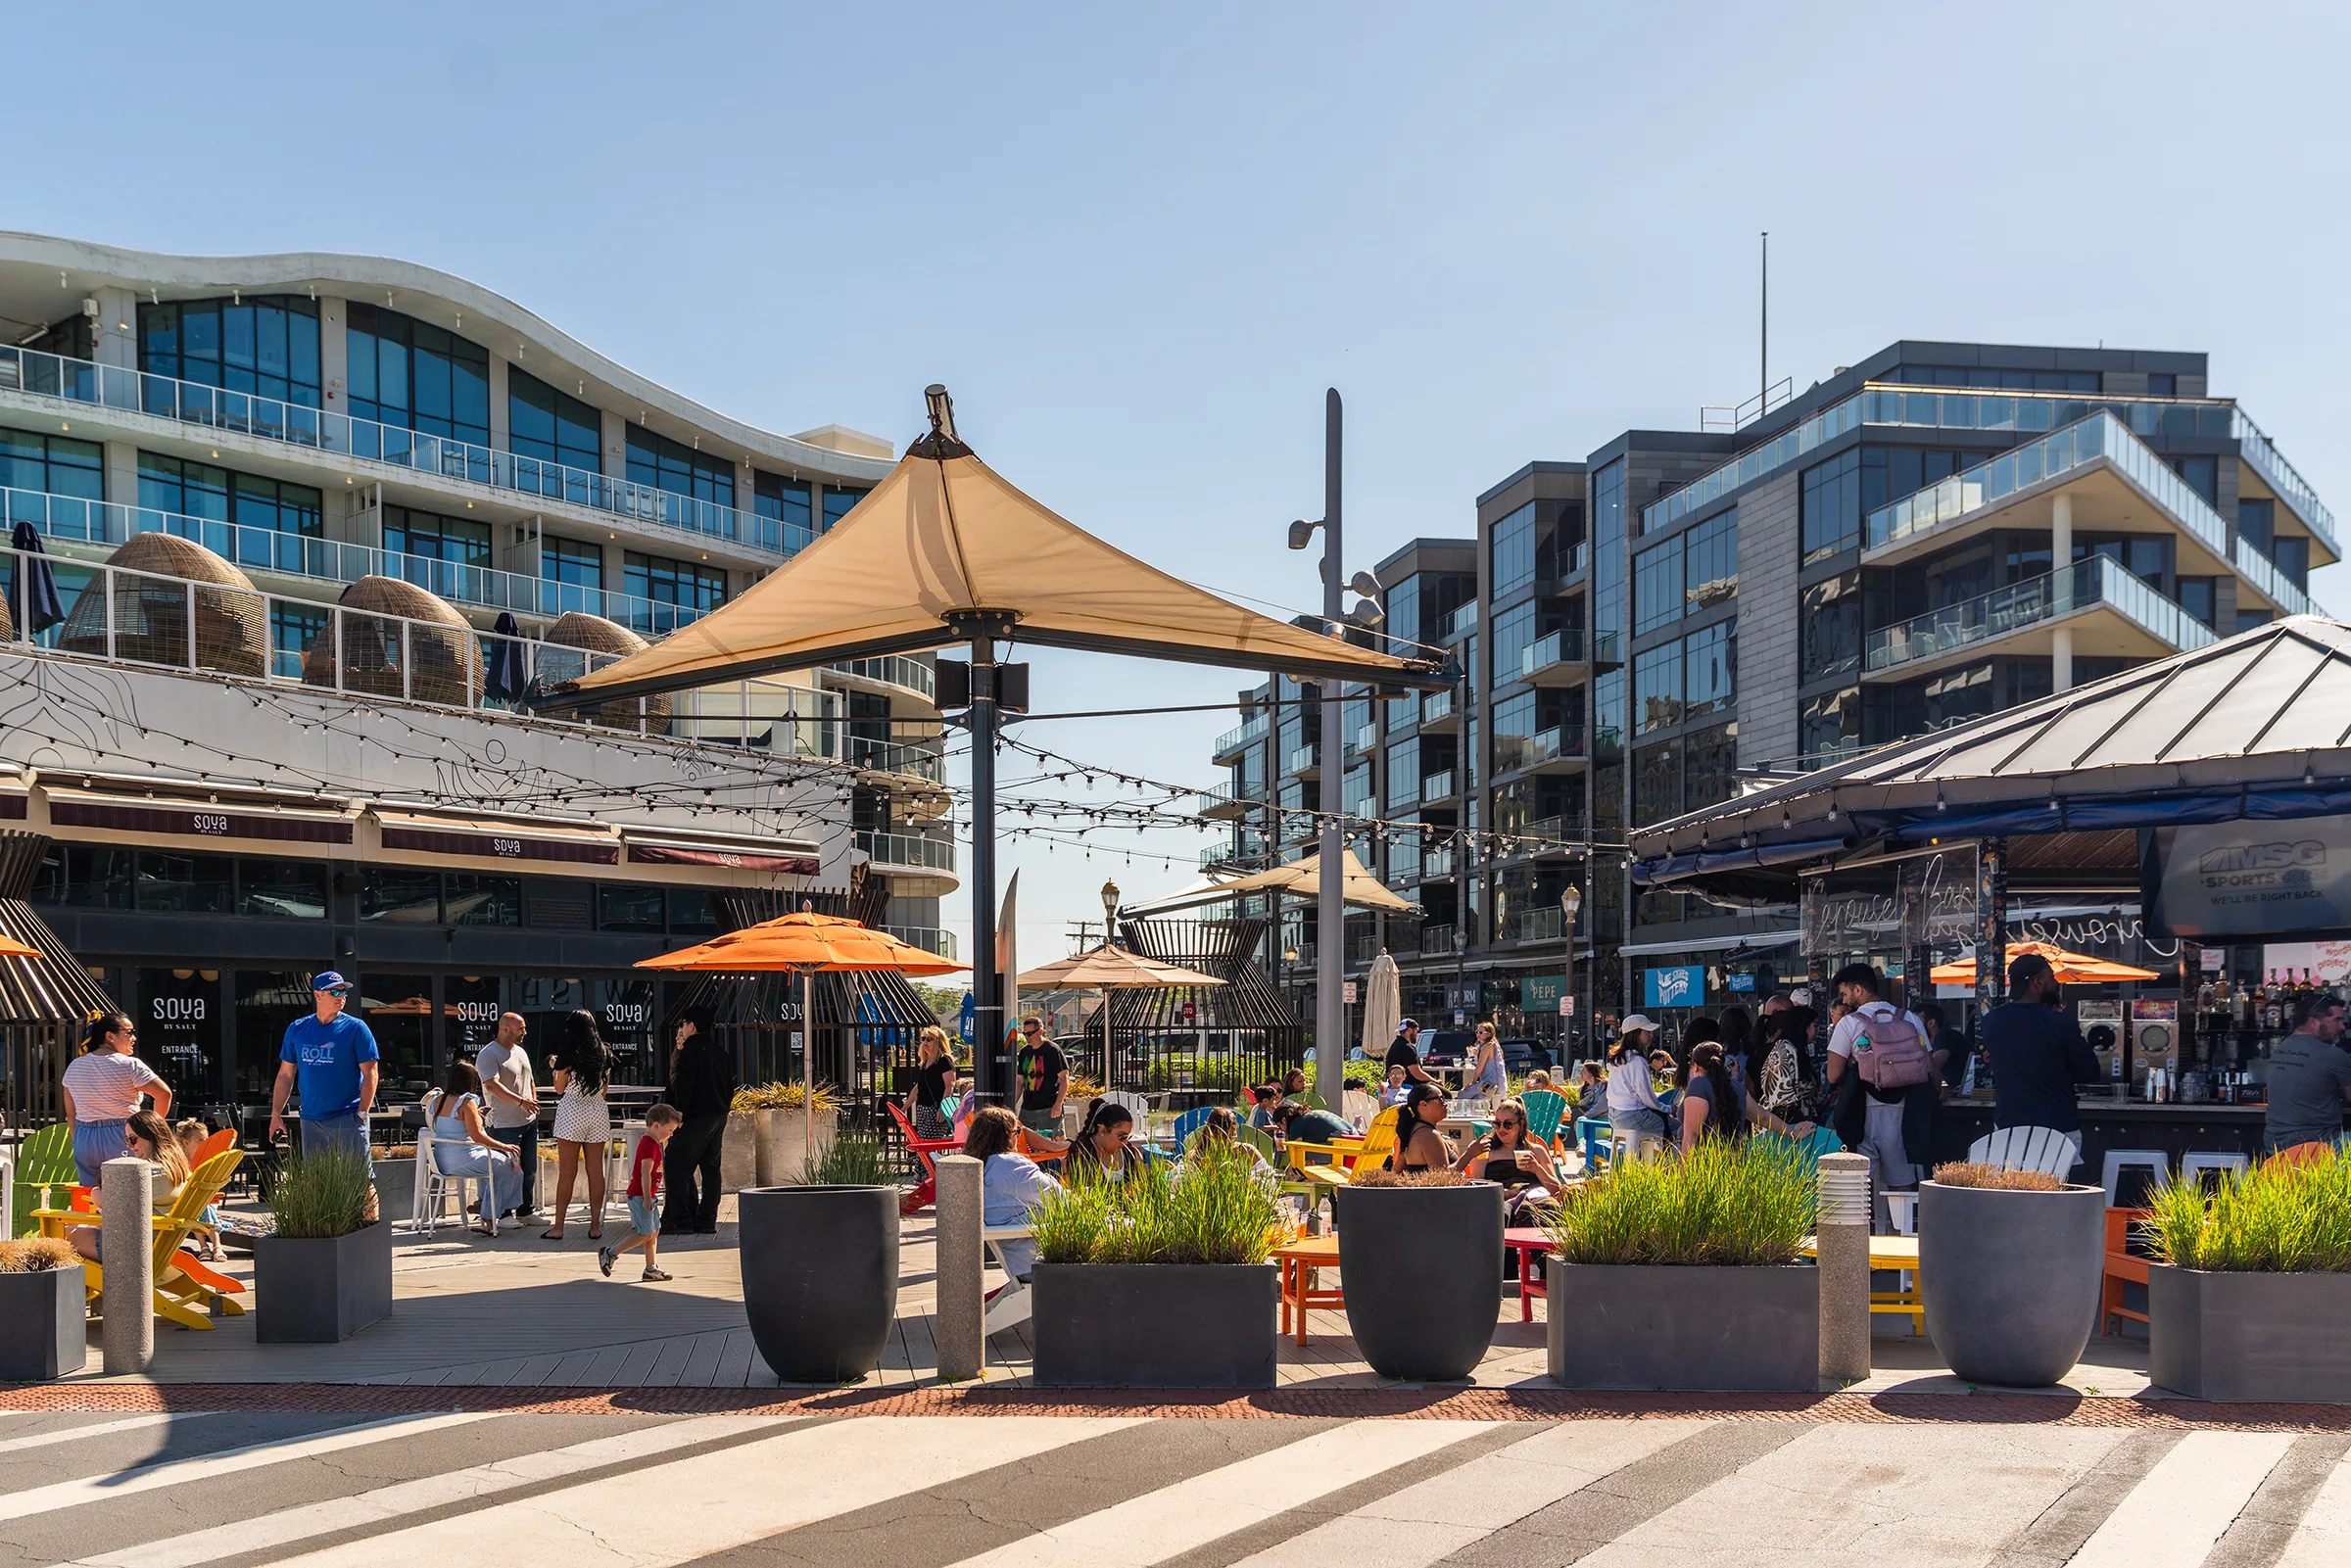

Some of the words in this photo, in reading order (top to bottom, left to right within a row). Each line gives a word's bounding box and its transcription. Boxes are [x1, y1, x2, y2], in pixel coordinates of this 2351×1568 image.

[2211, 894, 2242, 905] WE'LL
[2244, 893, 2259, 903] BE
[2261, 890, 2292, 902] RIGHT
[2294, 888, 2325, 900] BACK
[1532, 981, 1557, 999] PÉPE
[1657, 979, 1689, 1006] POTTERY
[161, 1045, 199, 1054] ENTRANCE
[301, 1047, 334, 1060] ROLL
